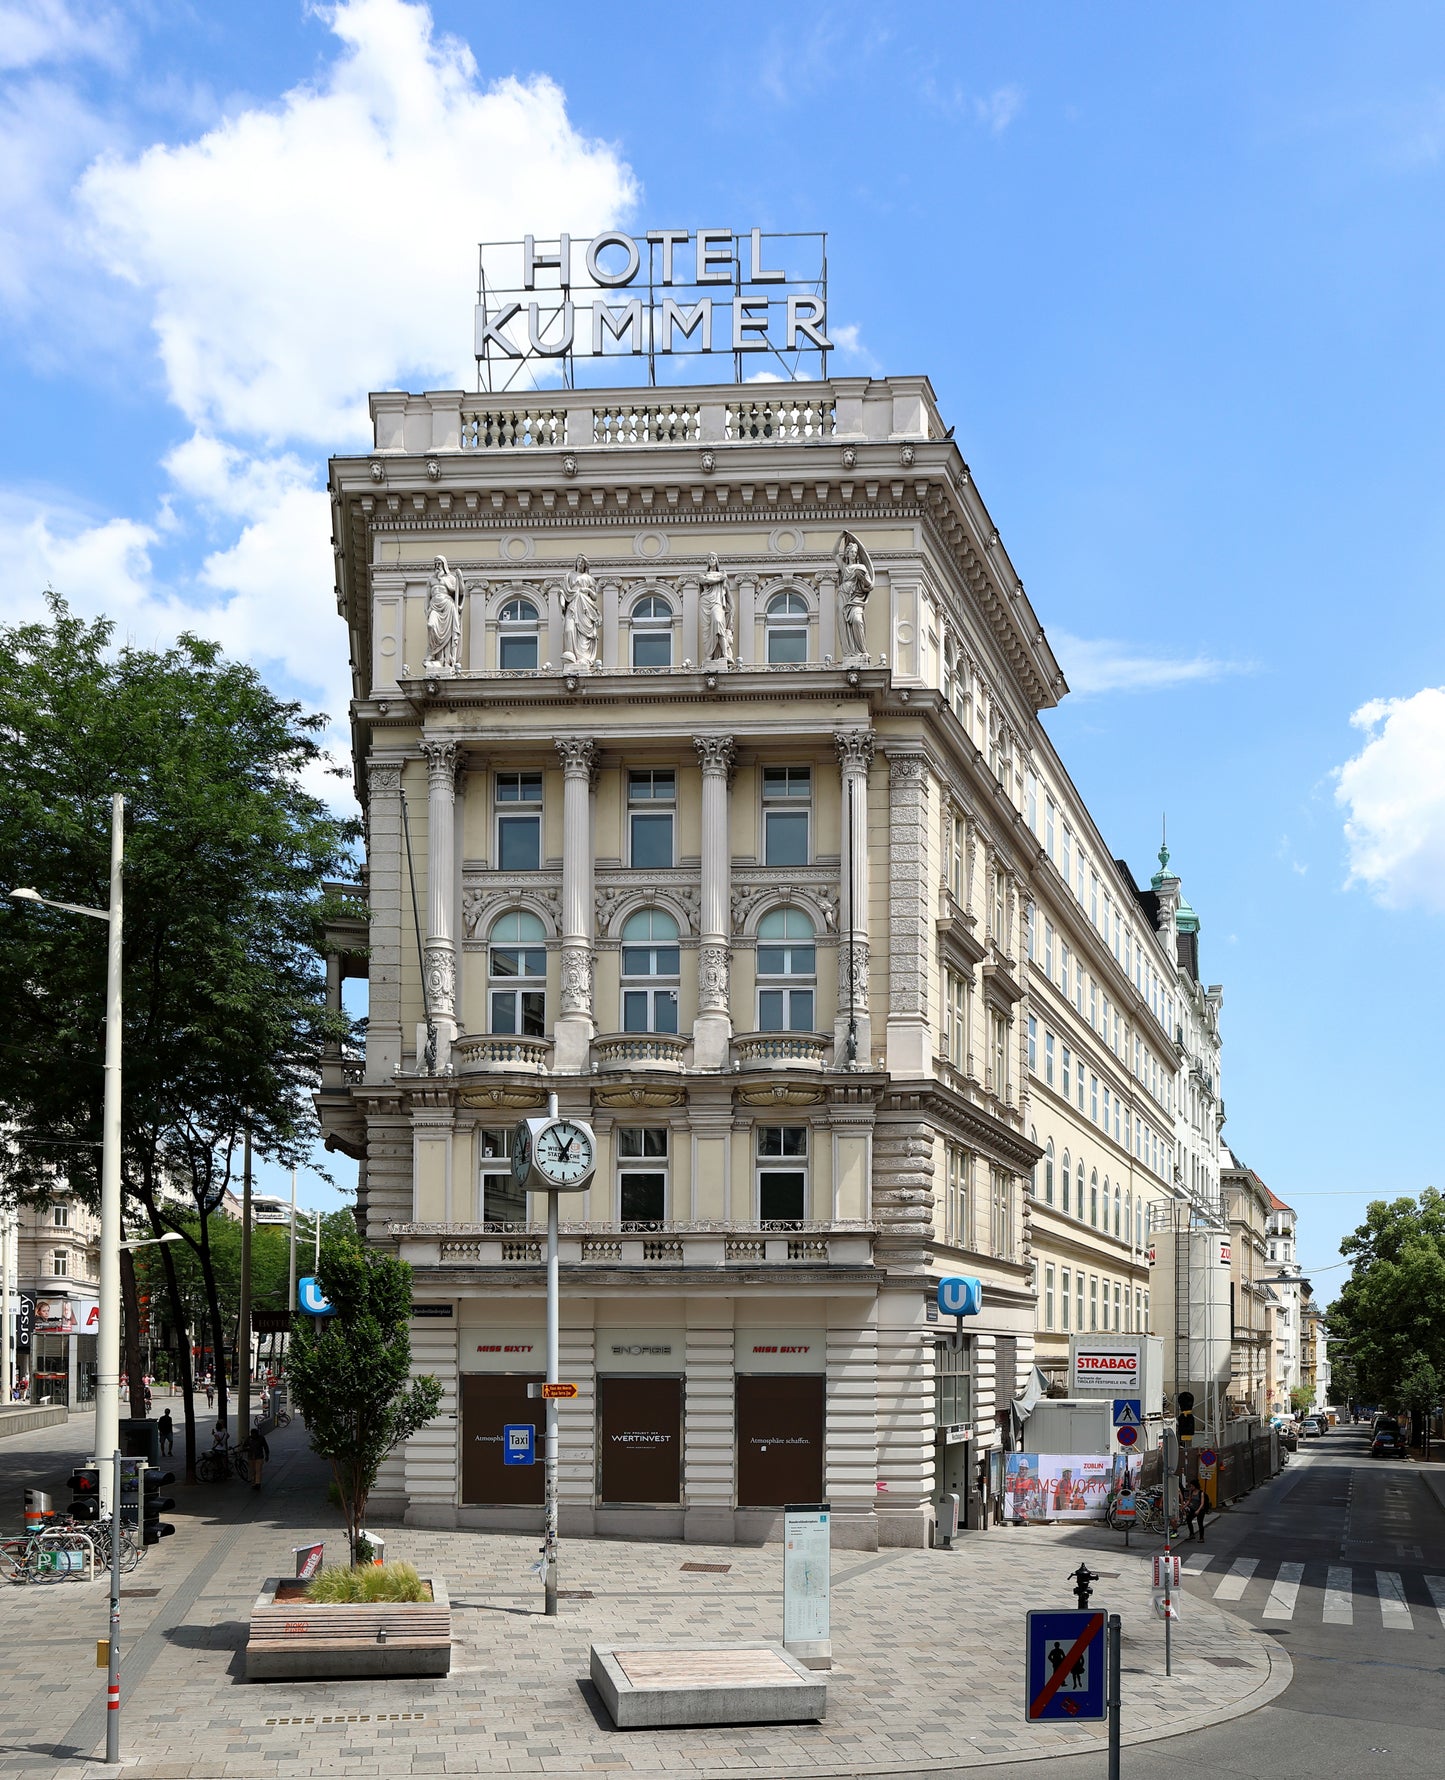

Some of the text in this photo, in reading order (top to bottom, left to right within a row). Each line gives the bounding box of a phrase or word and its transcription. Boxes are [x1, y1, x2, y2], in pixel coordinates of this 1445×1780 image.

[524, 228, 786, 291] HOTEL
[475, 295, 834, 361] KUMMER
[306, 1285, 330, 1310] U
[944, 1285, 966, 1310] U
[21, 1294, 35, 1345] orsay
[477, 1345, 533, 1353] MISS SIXTY
[1077, 1357, 1137, 1369] STRABAG
[475, 1435, 505, 1443] Atmosphä
[510, 1434, 529, 1446] Taxi
[750, 1437, 785, 1445] Atmosphäre
